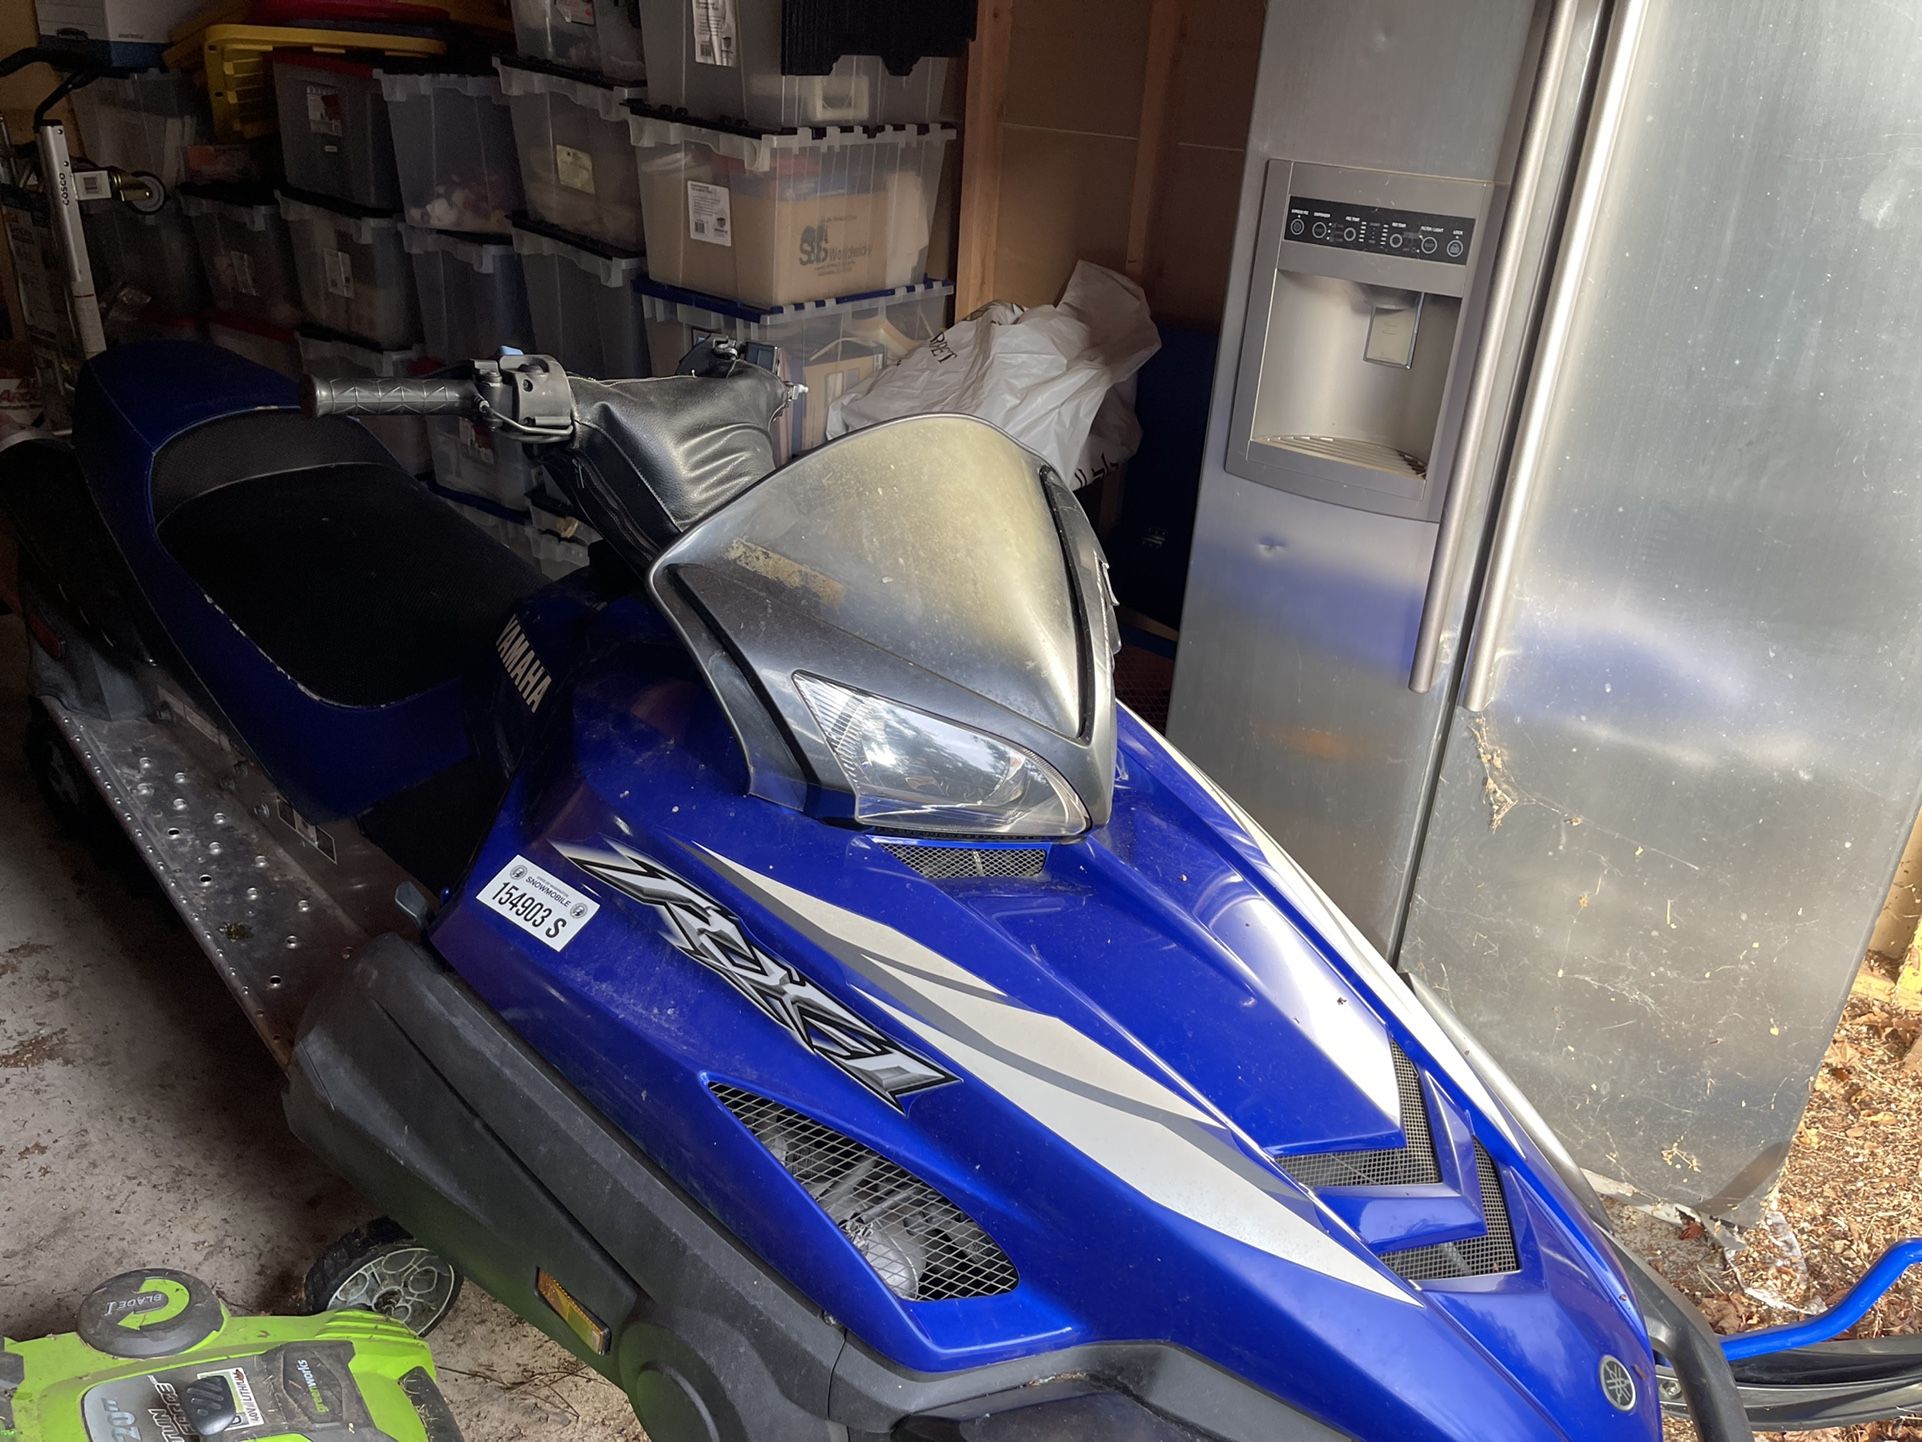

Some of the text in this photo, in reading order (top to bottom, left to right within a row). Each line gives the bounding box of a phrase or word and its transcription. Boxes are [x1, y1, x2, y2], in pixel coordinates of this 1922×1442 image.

[59, 172, 70, 206] COSCO
[495, 613, 552, 713] YAMAHA
[525, 876, 572, 908] SNOWMOBILE
[491, 881, 568, 939] 154903 S
[116, 1293, 162, 1311] BLADE
[296, 1359, 330, 1413] greenworks
[245, 1407, 260, 1422] 40V
